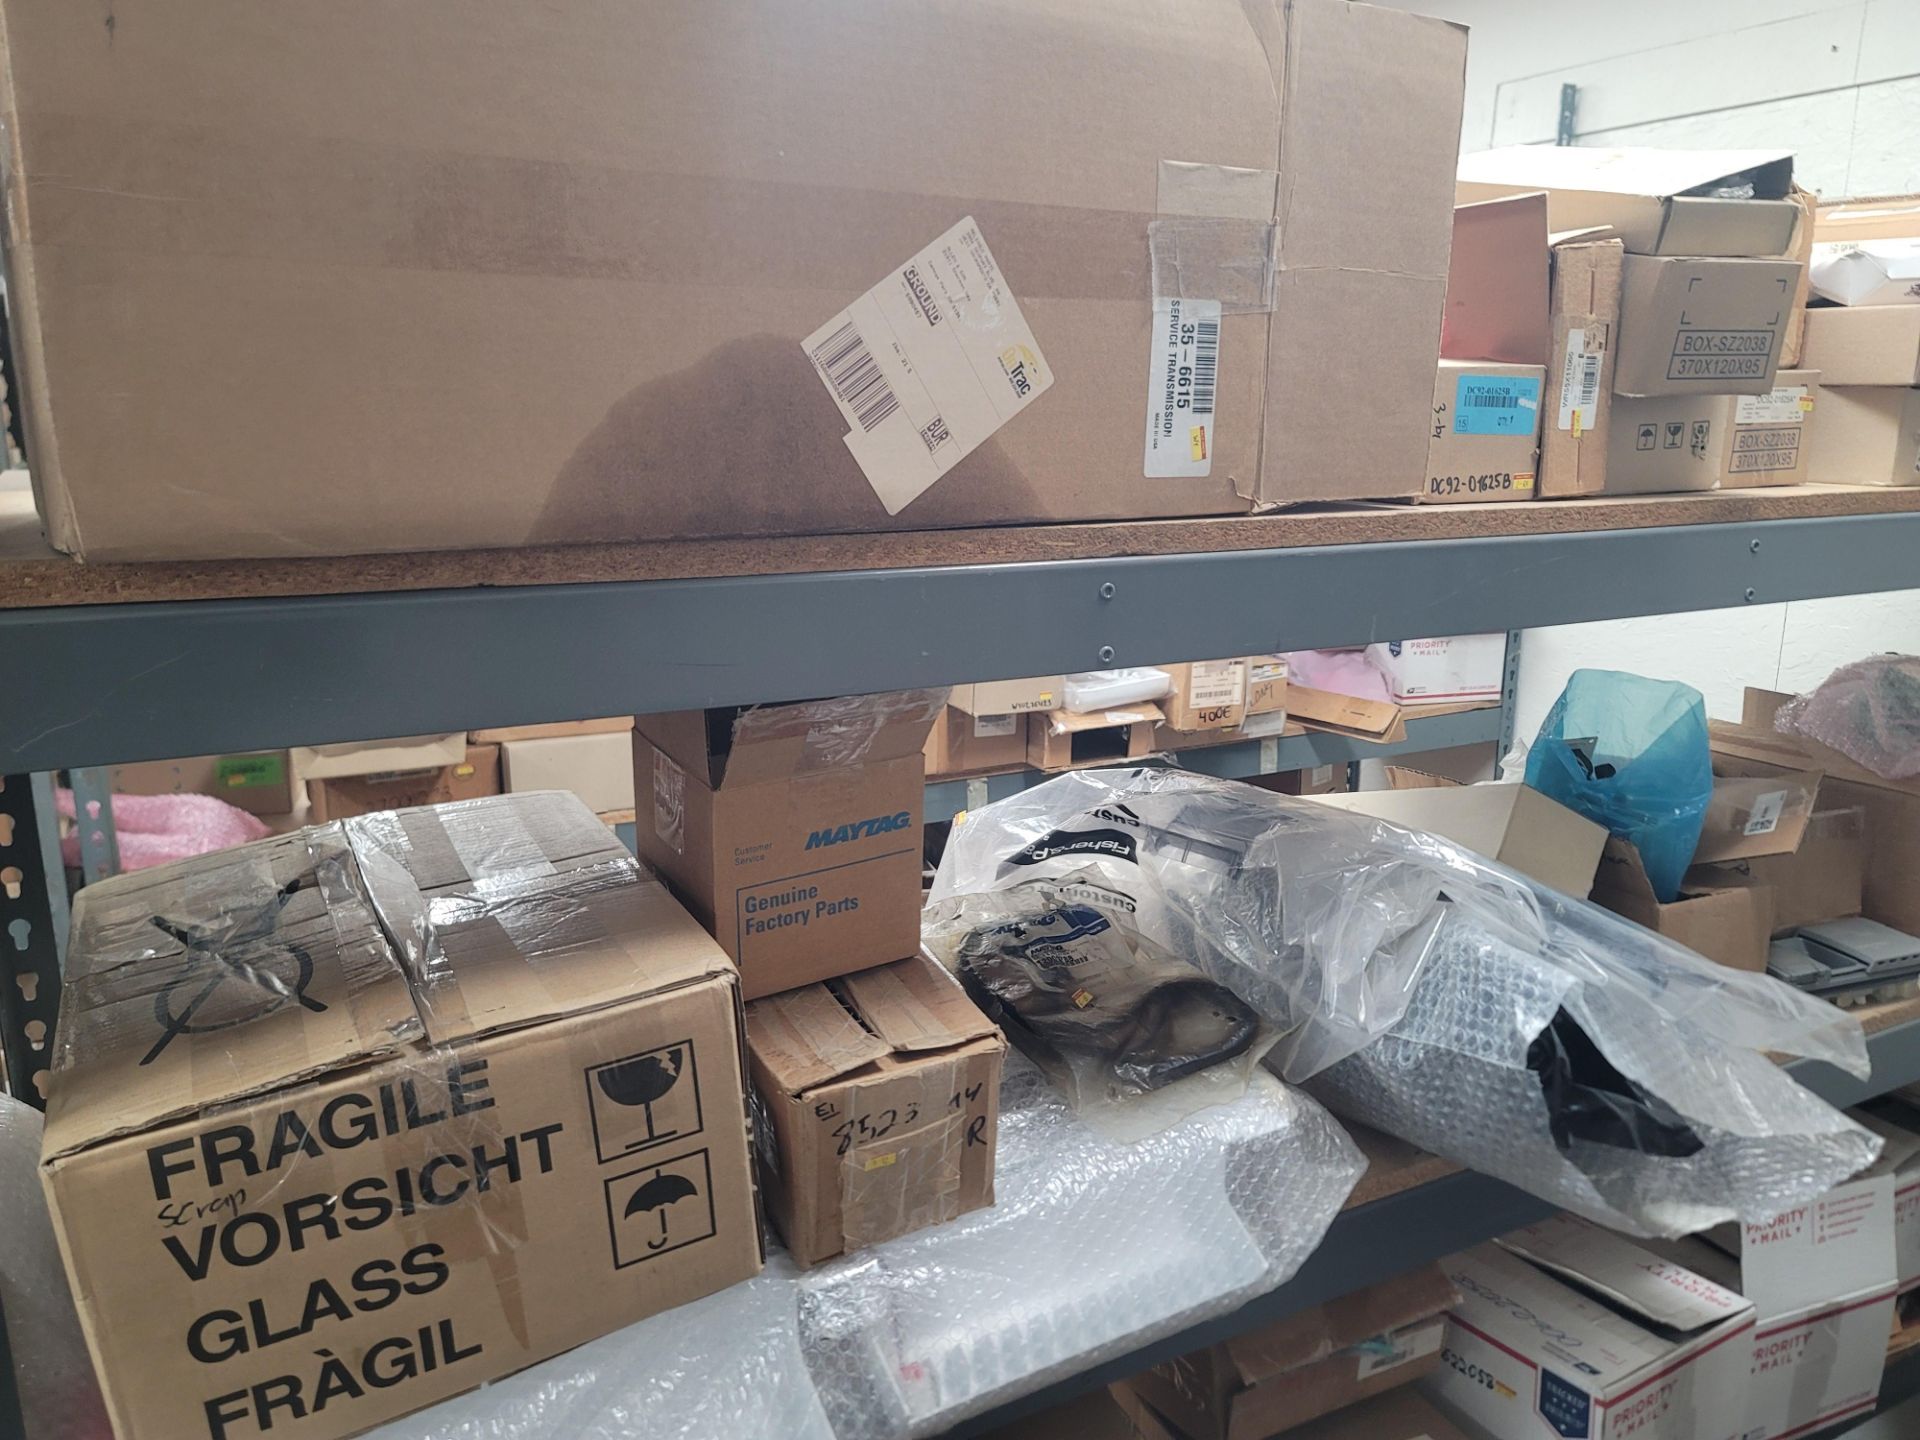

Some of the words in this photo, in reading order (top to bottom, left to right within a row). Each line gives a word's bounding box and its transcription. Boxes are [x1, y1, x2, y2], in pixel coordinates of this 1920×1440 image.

[905, 266, 943, 326] GROUND
[1168, 299, 1180, 348] SERVICE
[1683, 335, 1768, 352] BOX-SZ2038
[1677, 358, 1761, 375] 370X120X95
[1163, 351, 1177, 437] TRANSMISSION
[927, 417, 949, 447] BUR
[804, 811, 912, 850] MAYTAG
[734, 842, 773, 857] Customer
[734, 854, 766, 866] Service
[744, 886, 818, 914] Genuine
[746, 908, 811, 936] Factory
[815, 896, 860, 919] Parts
[146, 1058, 497, 1201] FRAGILE
[966, 1115, 988, 1148] R
[161, 1123, 565, 1281] VORSICHT
[1760, 1229, 1793, 1244] MAIL
[186, 1242, 451, 1364] GLASS
[203, 1319, 484, 1440] FRÀGIL
[1759, 1354, 1793, 1373] MAIL
[1612, 1378, 1678, 1429] PRIORITY
[1626, 1410, 1661, 1437] MAIL
